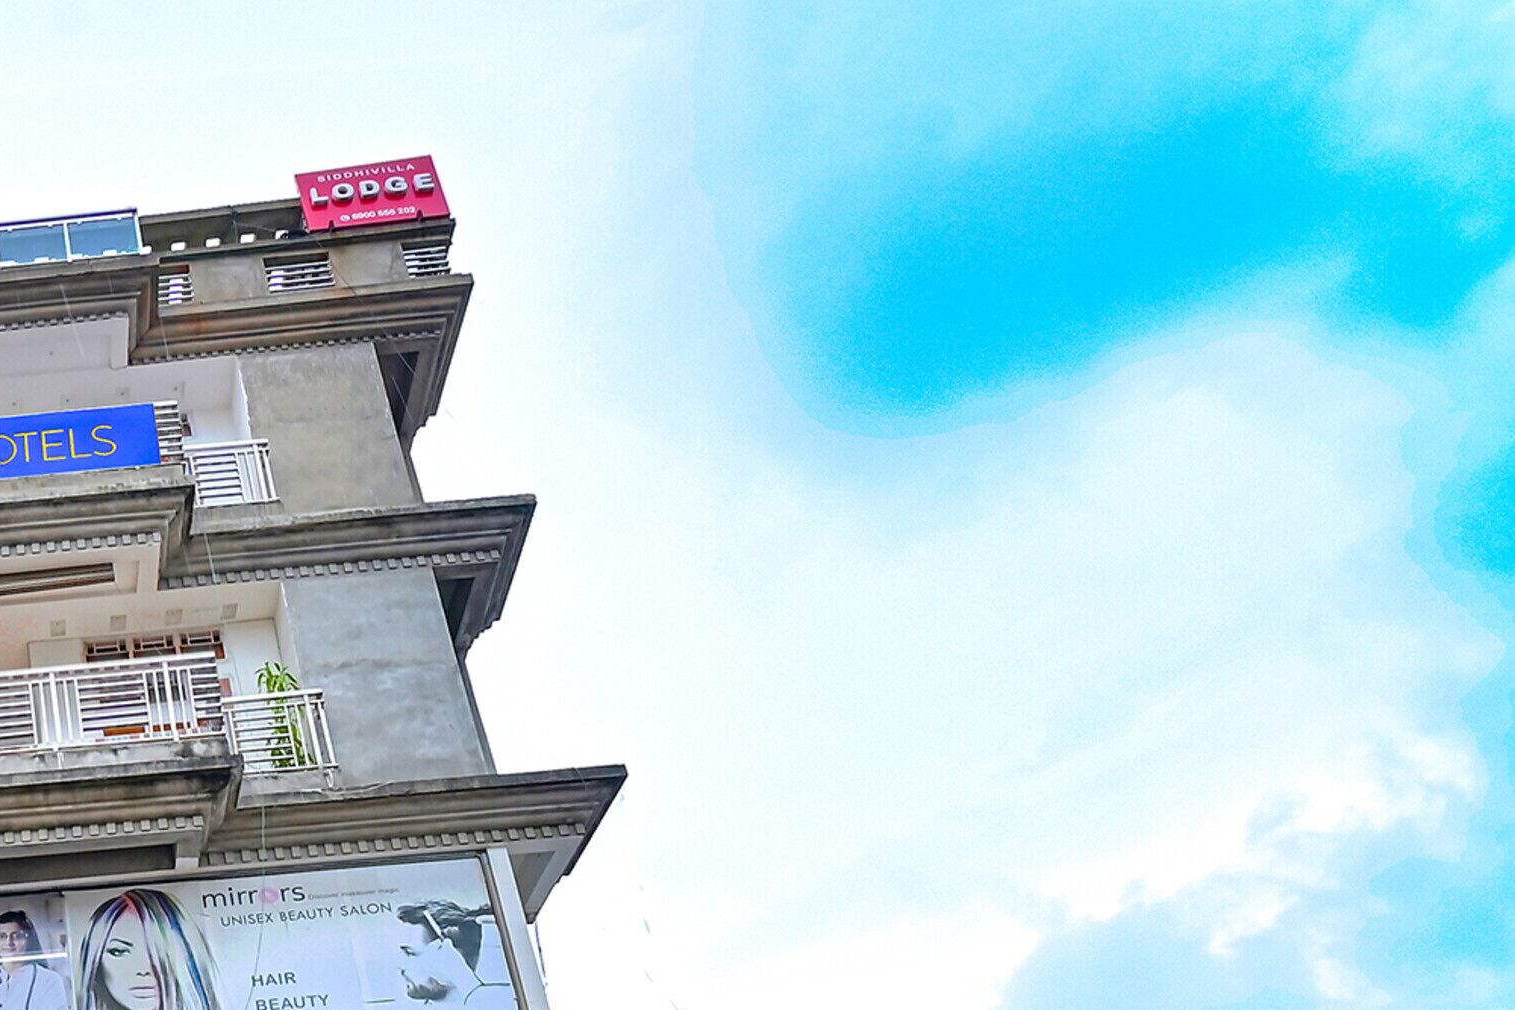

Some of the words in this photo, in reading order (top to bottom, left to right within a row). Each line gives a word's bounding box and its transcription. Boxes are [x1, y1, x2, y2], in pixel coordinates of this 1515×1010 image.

[317, 163, 416, 183] SIDDHIVILLA
[309, 173, 435, 206] LODGE
[202, 885, 306, 909] mirrors
[220, 912, 274, 928] UNISEX
[279, 907, 335, 922] BEAUTY
[340, 902, 393, 917] SALON
[251, 971, 297, 987] HAIR
